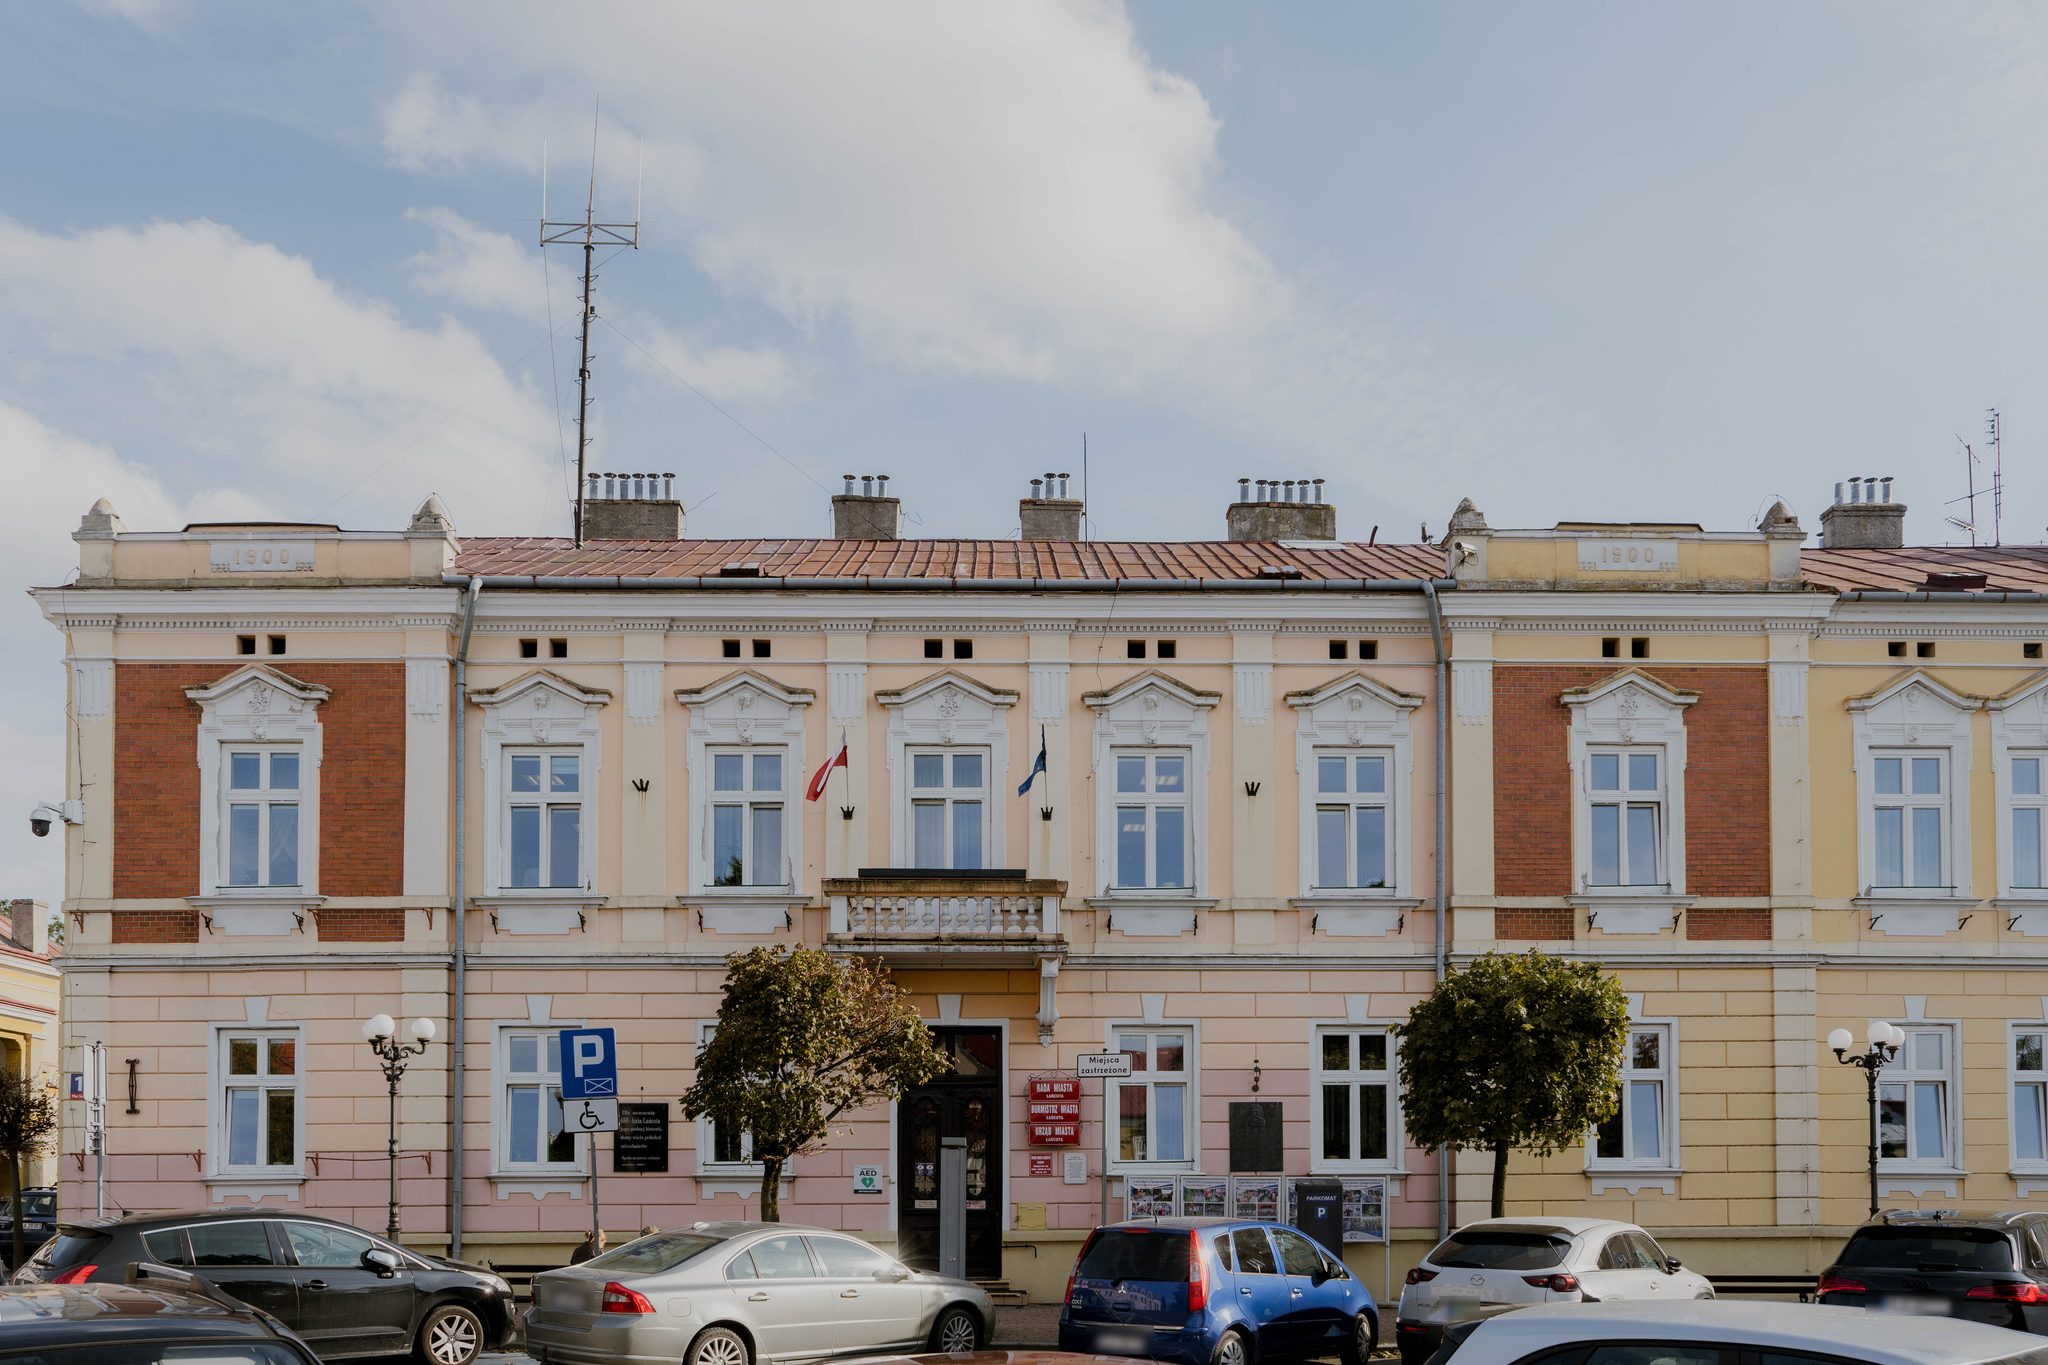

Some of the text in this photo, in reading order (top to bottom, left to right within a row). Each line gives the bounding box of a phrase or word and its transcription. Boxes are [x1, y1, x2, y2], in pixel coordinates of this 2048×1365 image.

[235, 548, 289, 565] 1900
[1602, 546, 1654, 563] 1900
[572, 1035, 605, 1078] P
[1089, 1056, 1119, 1065] Miejsca
[1081, 1066, 1127, 1074] zastrzeżone
[1036, 1083, 1072, 1092] RADA MIASTA
[1031, 1104, 1078, 1114] BURMISTRZ MIASTA
[1035, 1126, 1074, 1136] URZĄD MIASTA
[1318, 1207, 1326, 1218] P
